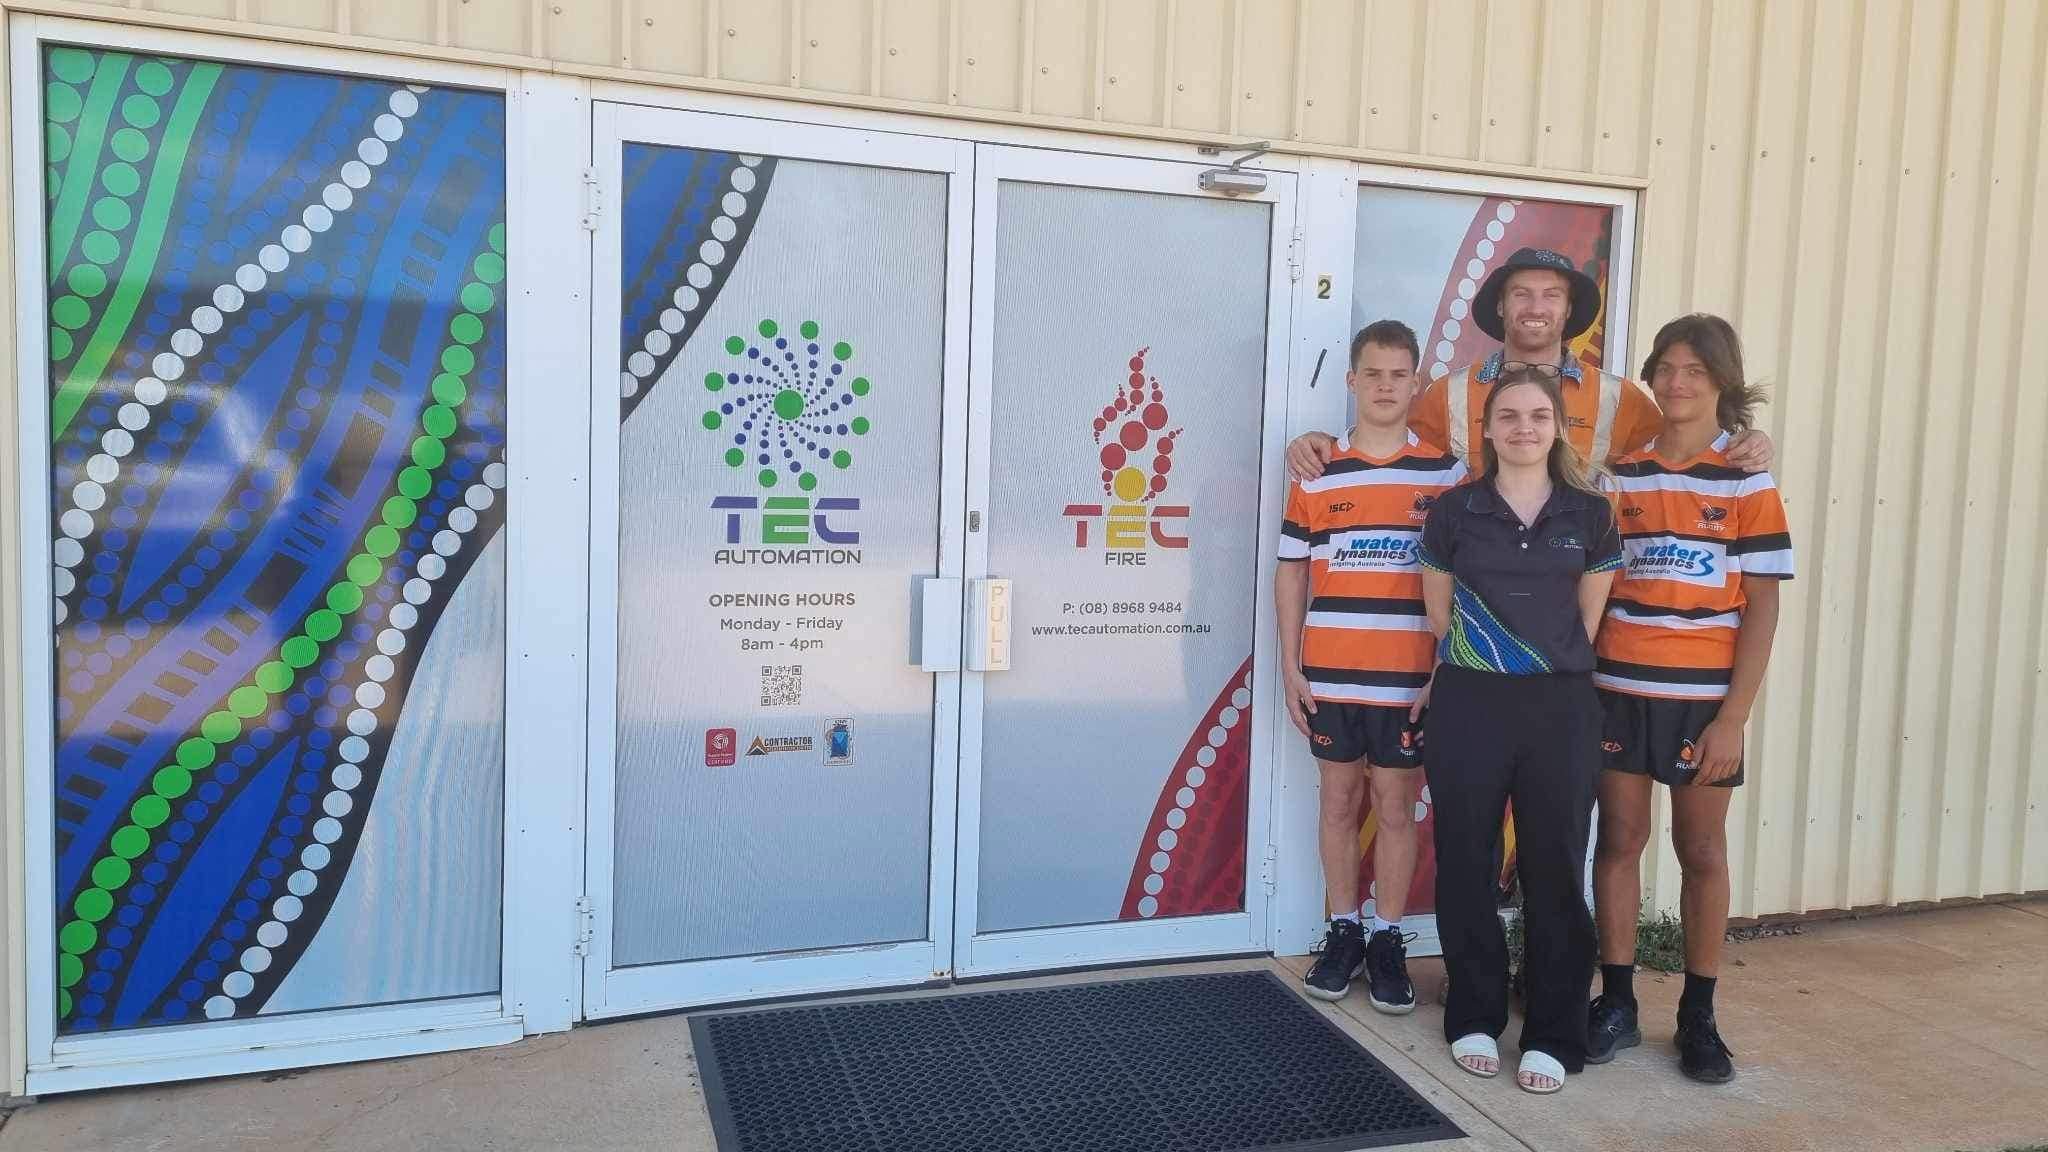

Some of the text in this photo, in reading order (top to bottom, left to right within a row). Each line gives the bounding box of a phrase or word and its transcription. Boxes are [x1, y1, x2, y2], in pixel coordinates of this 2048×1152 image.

[1318, 278, 1331, 300] 2
[710, 496, 860, 544] TEC
[1062, 504, 1190, 549] TEC
[1350, 536, 1413, 551] water
[714, 549, 861, 565] AUTOMATION
[1105, 552, 1147, 566] FIRE
[1643, 543, 1702, 563] water
[709, 592, 855, 608] OPENING HOURS
[1063, 602, 1182, 615] P: (08) 8968 9484
[720, 617, 781, 632] Monday
[796, 616, 843, 631] Friday
[991, 584, 1004, 664] PULL
[1031, 623, 1211, 636] www.tecautomation.com.au
[741, 638, 774, 651] 8am
[789, 638, 824, 652] 4pm
[764, 737, 813, 747] CONTRACTOR
